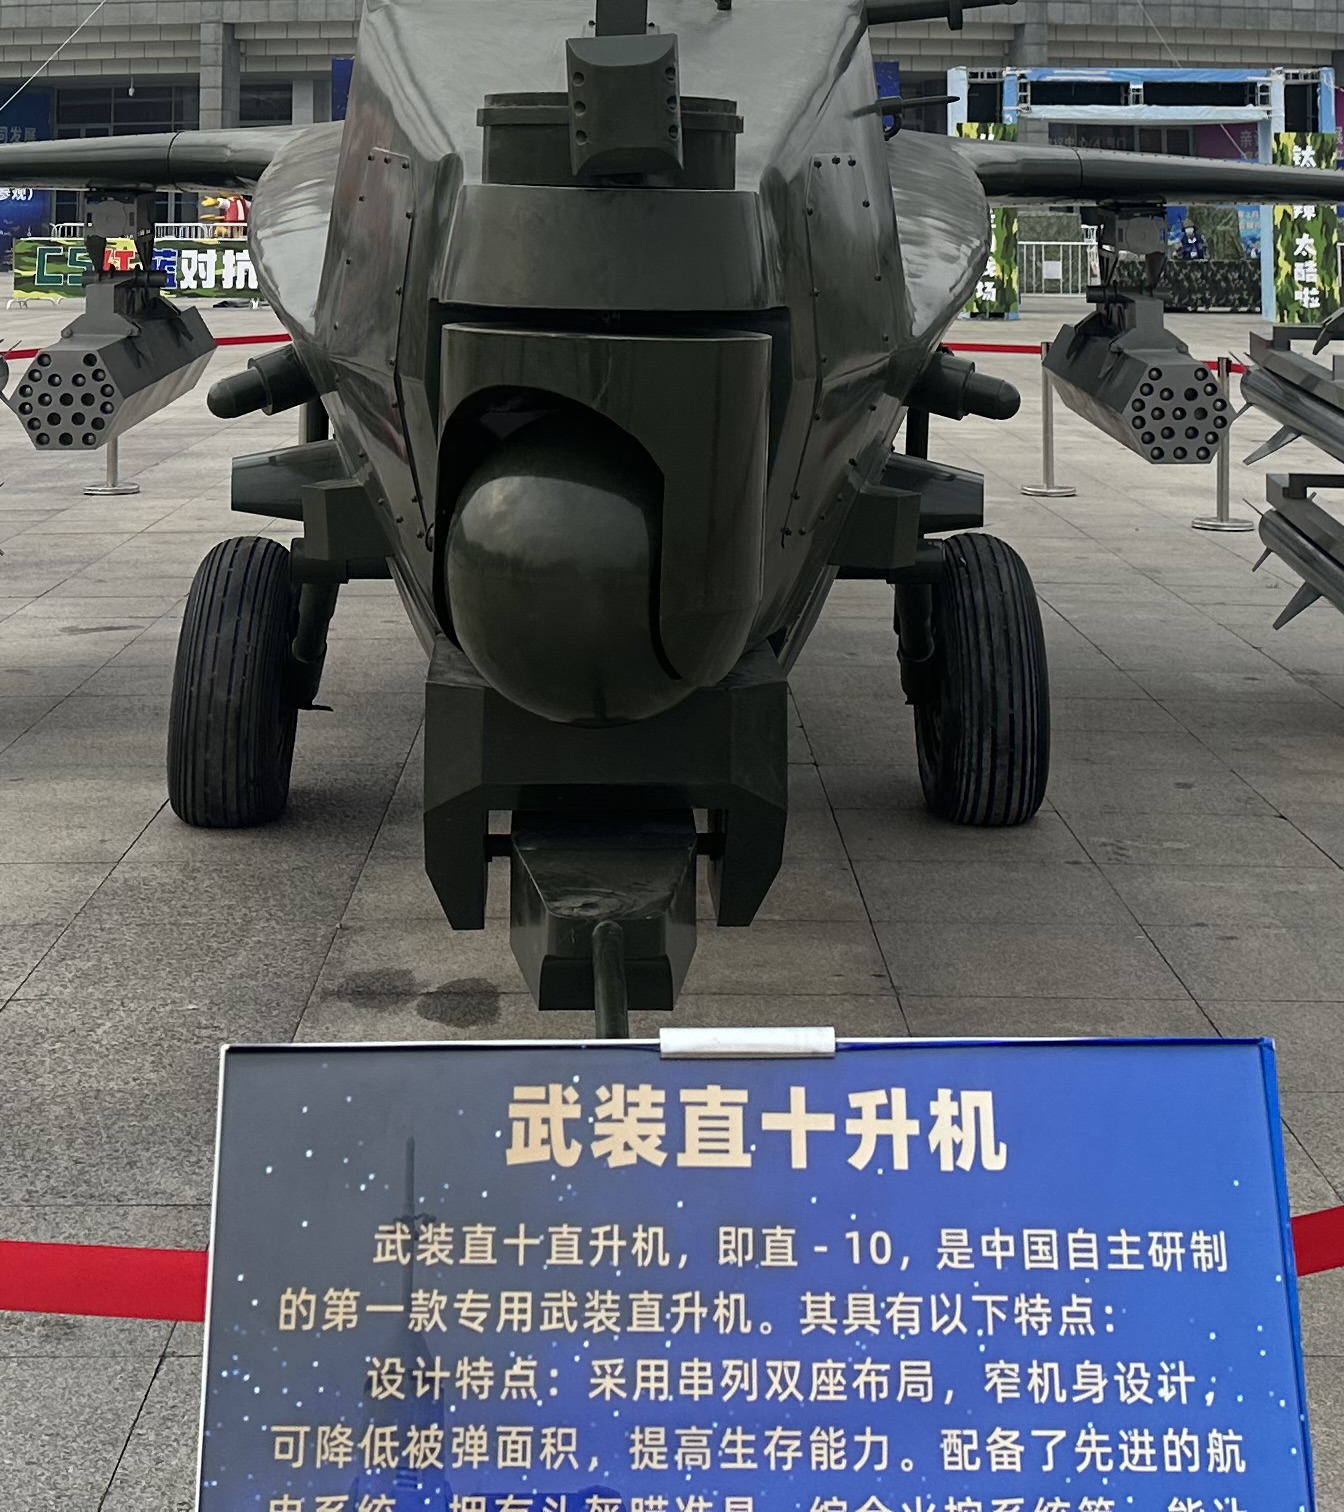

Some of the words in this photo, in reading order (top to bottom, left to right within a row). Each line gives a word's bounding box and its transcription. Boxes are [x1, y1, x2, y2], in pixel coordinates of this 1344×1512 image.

[506, 1084, 1007, 1172] 武装直十升机
